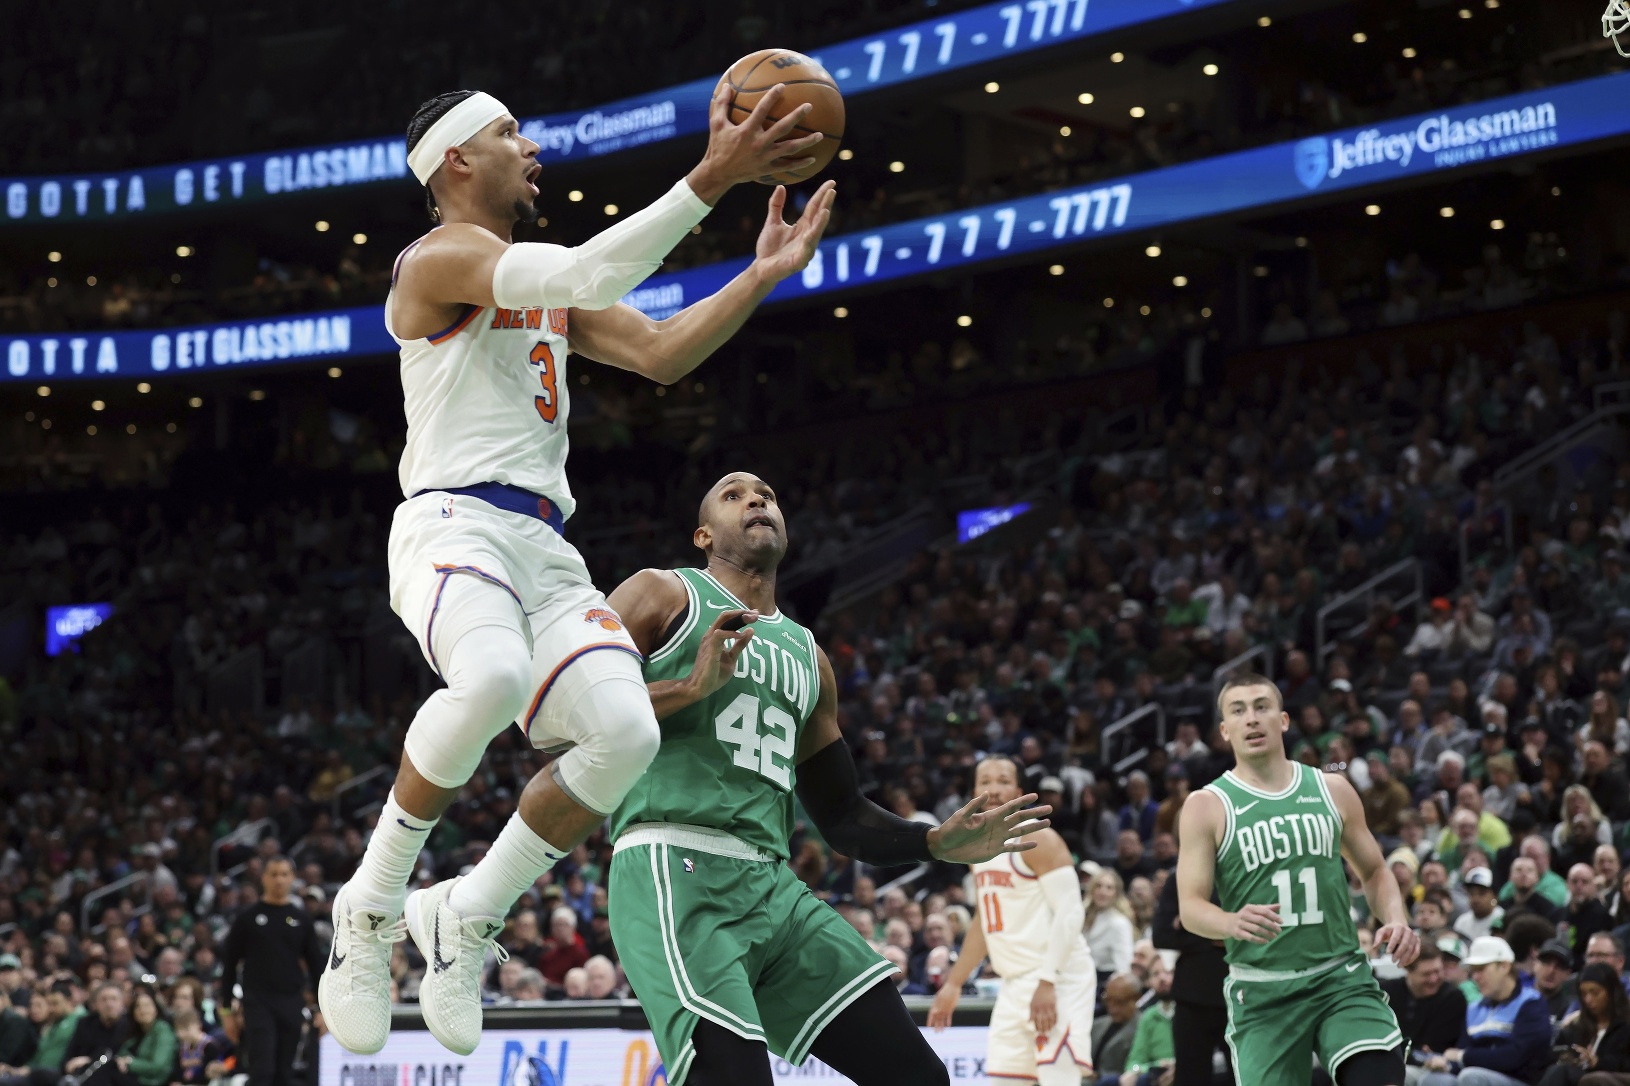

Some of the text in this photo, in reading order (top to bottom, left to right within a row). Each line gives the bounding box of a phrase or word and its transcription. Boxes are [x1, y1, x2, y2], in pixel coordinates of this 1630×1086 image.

[576, 100, 677, 145] Glassman
[1328, 101, 1557, 178] Jeffrey Glassman
[6, 139, 407, 219] GOTTA GET GLASSMAN
[7, 315, 351, 377] OTTA GET GLASSMAN
[530, 341, 560, 425] 3
[722, 629, 811, 721] OSTON
[714, 692, 797, 791] 42
[1236, 813, 1336, 873] BOSTON
[983, 892, 1004, 934] 11
[1271, 866, 1324, 928] 11
